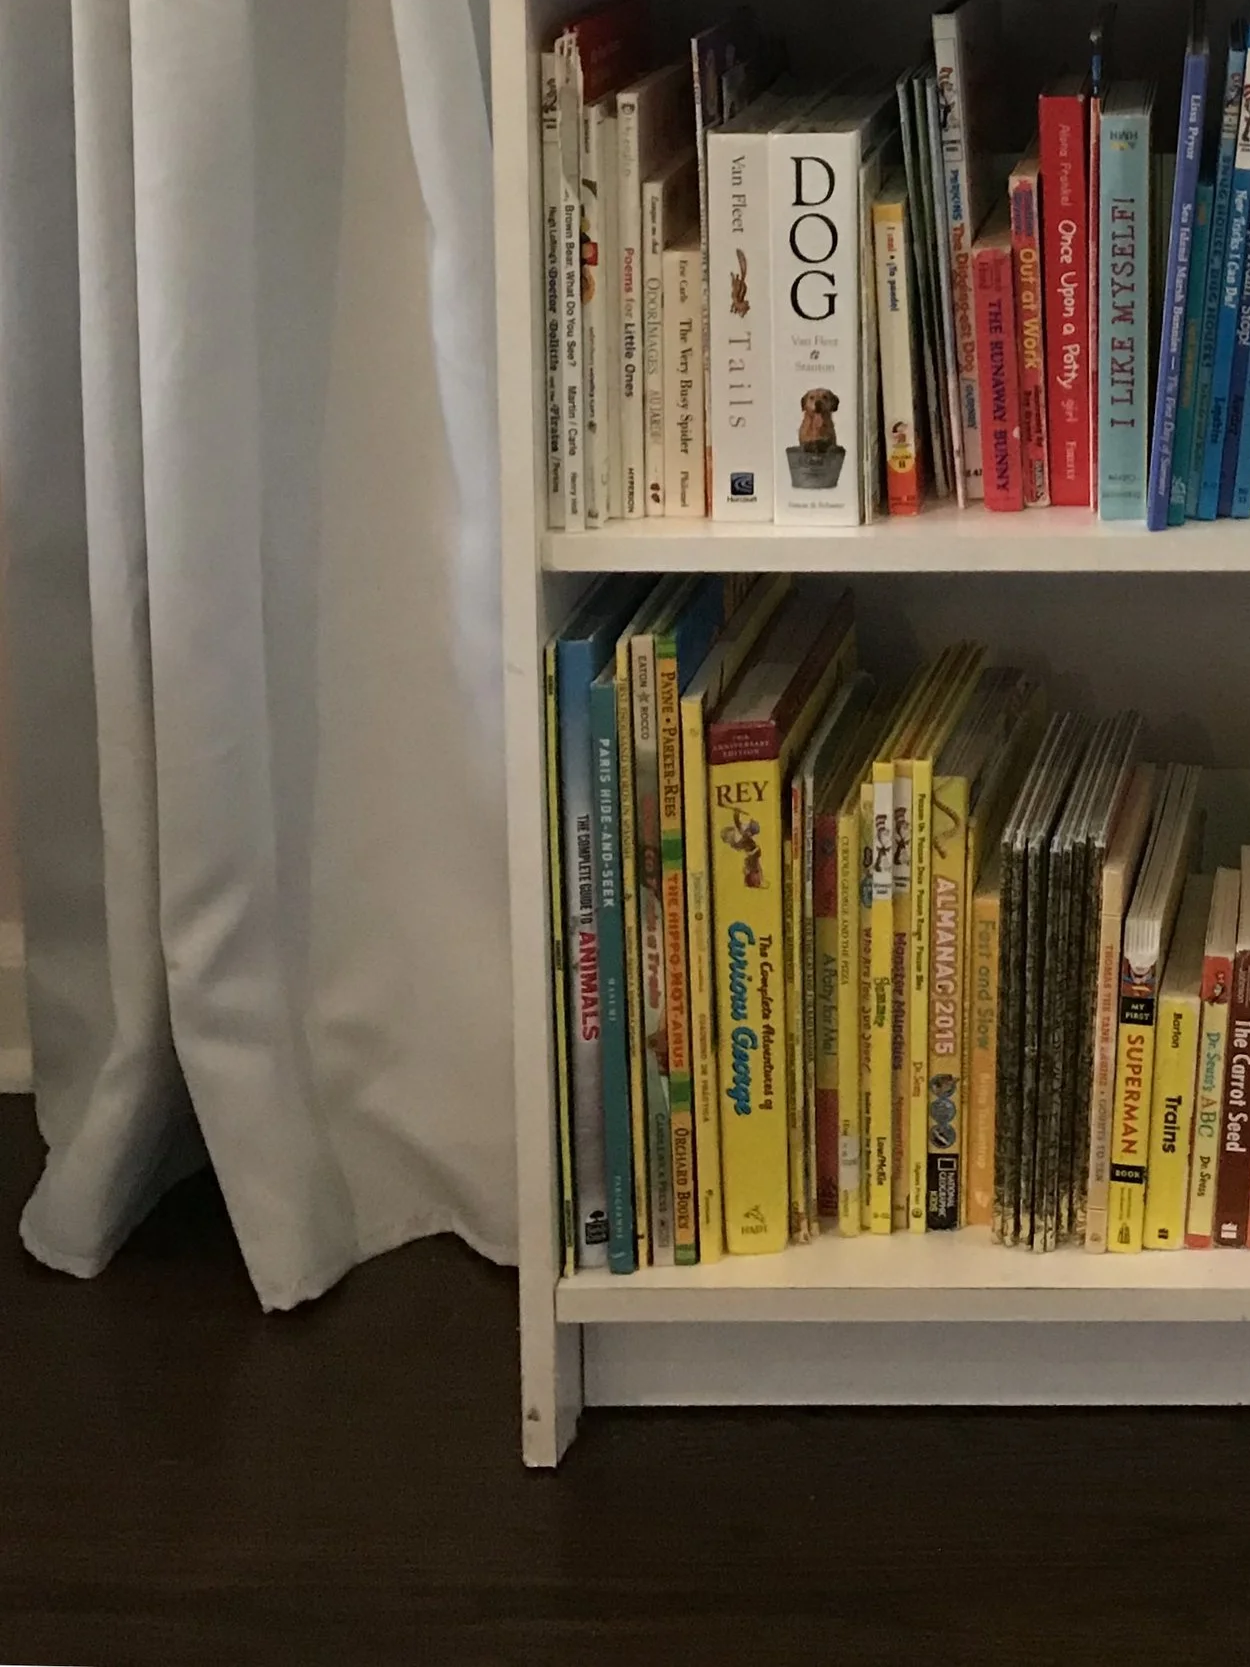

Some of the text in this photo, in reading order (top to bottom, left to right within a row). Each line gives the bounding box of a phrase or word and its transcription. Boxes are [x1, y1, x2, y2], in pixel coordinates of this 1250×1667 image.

[1184, 94, 1202, 160] Lissa Pryor
[565, 205, 575, 238] Brown
[731, 155, 747, 233] Van Fleet
[789, 156, 838, 321] DOG
[1019, 248, 1036, 283] Out
[566, 271, 576, 297] What
[567, 301, 576, 315] Do
[1021, 290, 1036, 311] at
[1056, 220, 1080, 389] Once Upon a Potty
[1110, 198, 1135, 428] I LIKE MYSELF!
[566, 318, 576, 337] You
[624, 248, 636, 397] Poems for Little Ones
[988, 299, 1002, 334] THE
[1023, 318, 1040, 369] Work
[567, 340, 576, 367] See?
[728, 331, 753, 428] Tails
[990, 340, 1008, 422] RUNAWAY
[677, 318, 693, 455] The Very Busy Spider
[1061, 399, 1077, 423] girl
[627, 468, 635, 513] HYPERION
[993, 429, 1010, 492] BUNNY
[660, 671, 678, 818] PAYNE PARKER-REES
[598, 738, 615, 907] PARIS HIDE-AND-SEEK
[714, 781, 769, 808] REY
[576, 814, 600, 1041] THE COMPLETE GUIDE TO ANIMALS
[933, 877, 958, 1055] ALMANAC 2015
[726, 922, 759, 1116] Curious George
[756, 934, 776, 1110] The Complete Adventures of
[1130, 1003, 1145, 1011] MY
[1171, 1012, 1184, 1049] Barton
[1120, 1034, 1145, 1154] SUPERMAN
[1197, 1031, 1222, 1138] Dr. Seuss's ABC
[1161, 1095, 1182, 1154] Trains
[1224, 1112, 1245, 1152] Seed
[1115, 1169, 1141, 1178] BOOK
[1196, 1155, 1213, 1197] Dr. Seuss
